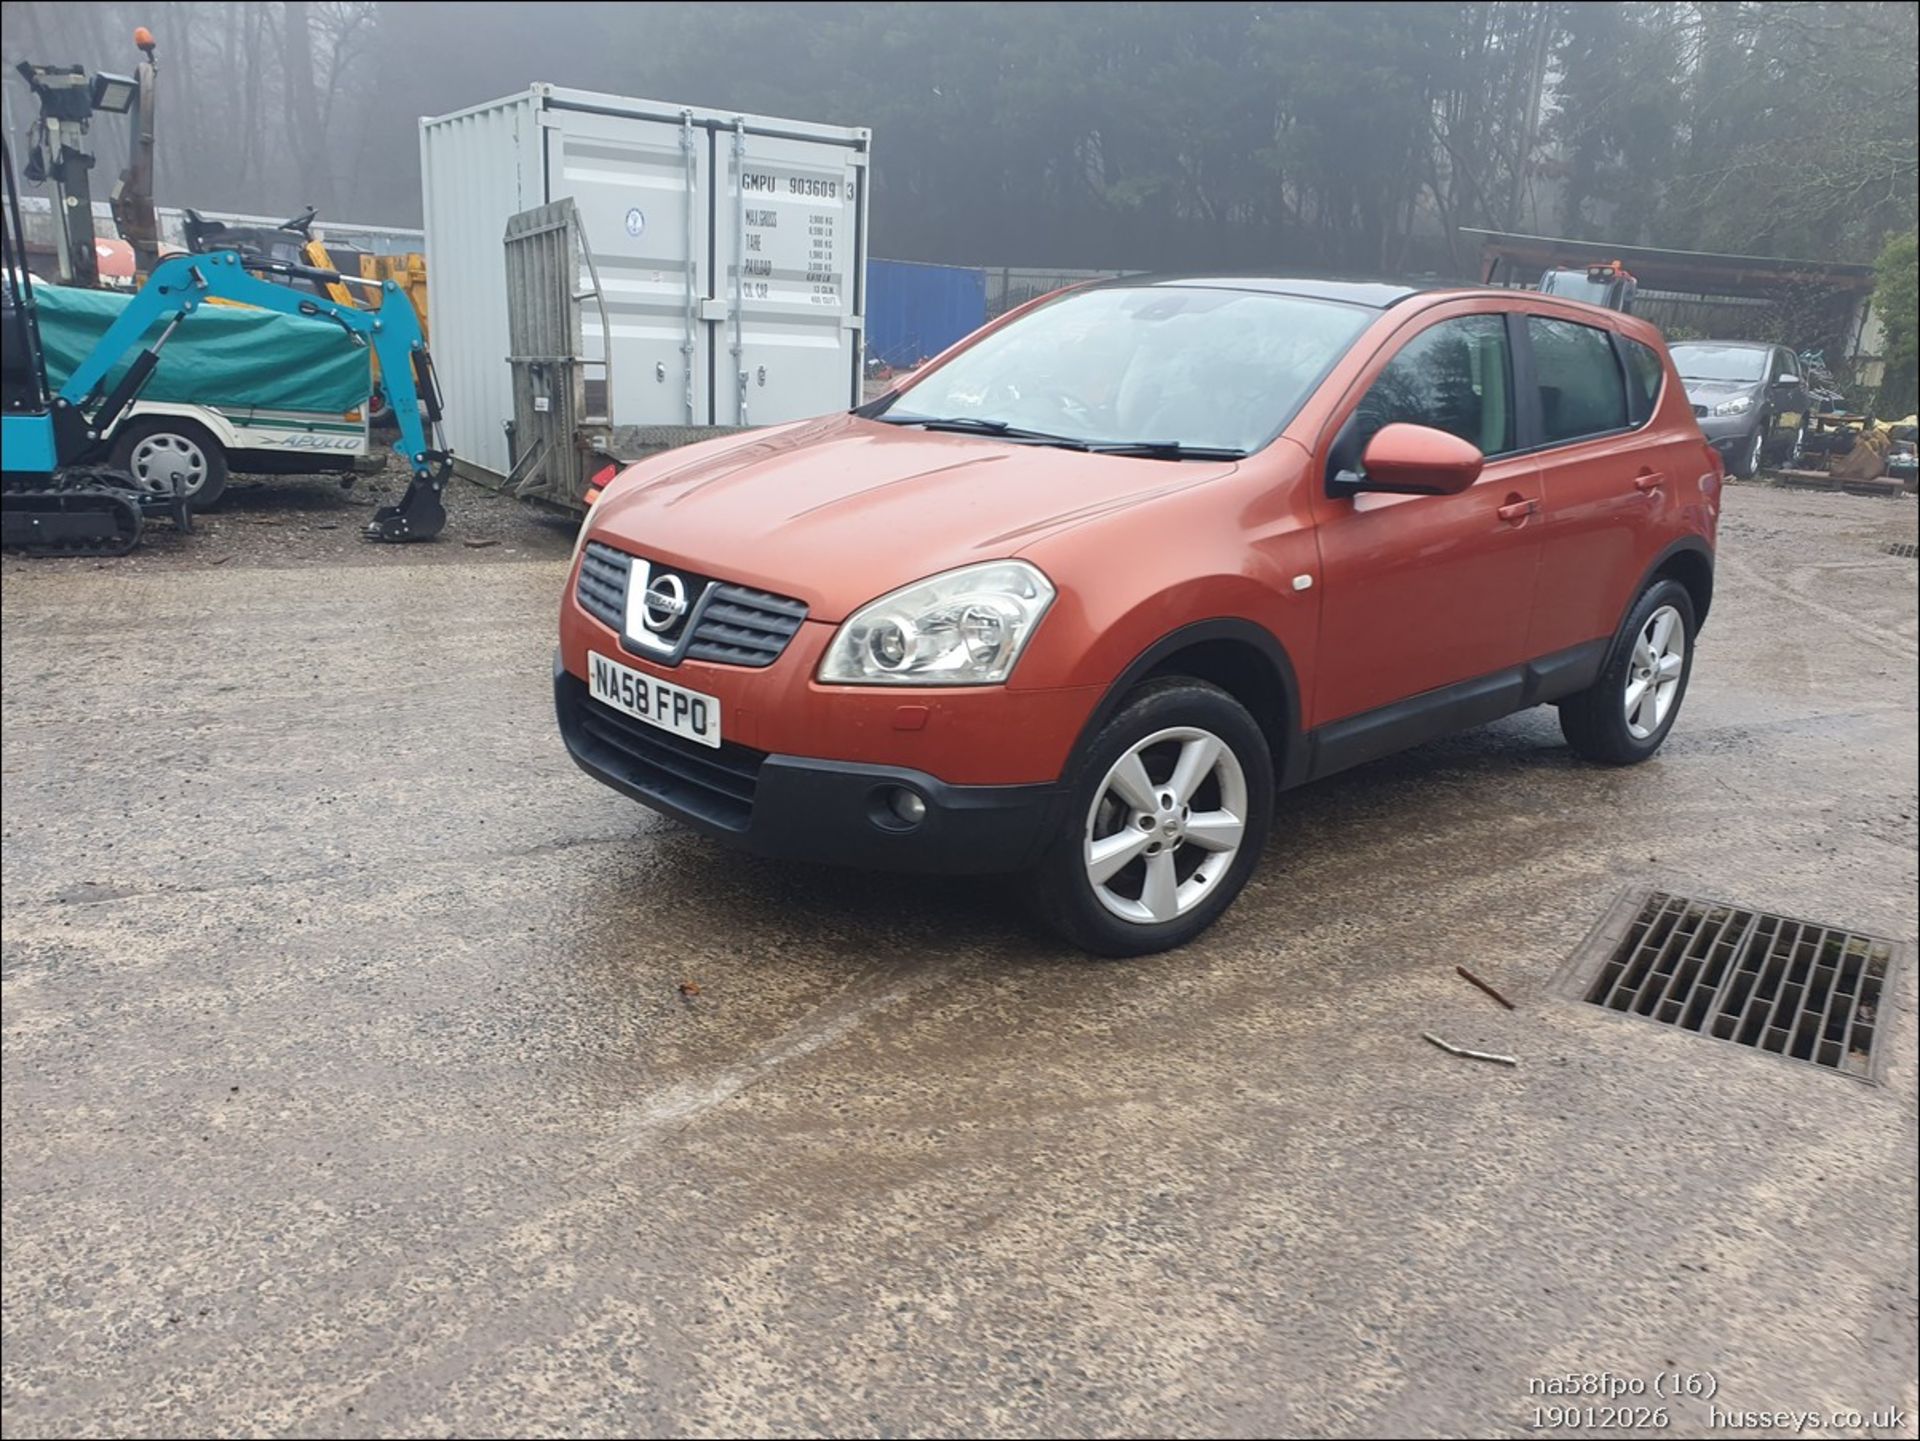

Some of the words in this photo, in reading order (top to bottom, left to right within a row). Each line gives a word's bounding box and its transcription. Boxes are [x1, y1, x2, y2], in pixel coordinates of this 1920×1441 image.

[742, 173, 776, 193] GMPU
[789, 177, 836, 198] 903609
[847, 183, 854, 200] 3
[282, 435, 361, 449] APOLLO
[595, 659, 649, 714] NA58
[656, 685, 707, 736] FPO
